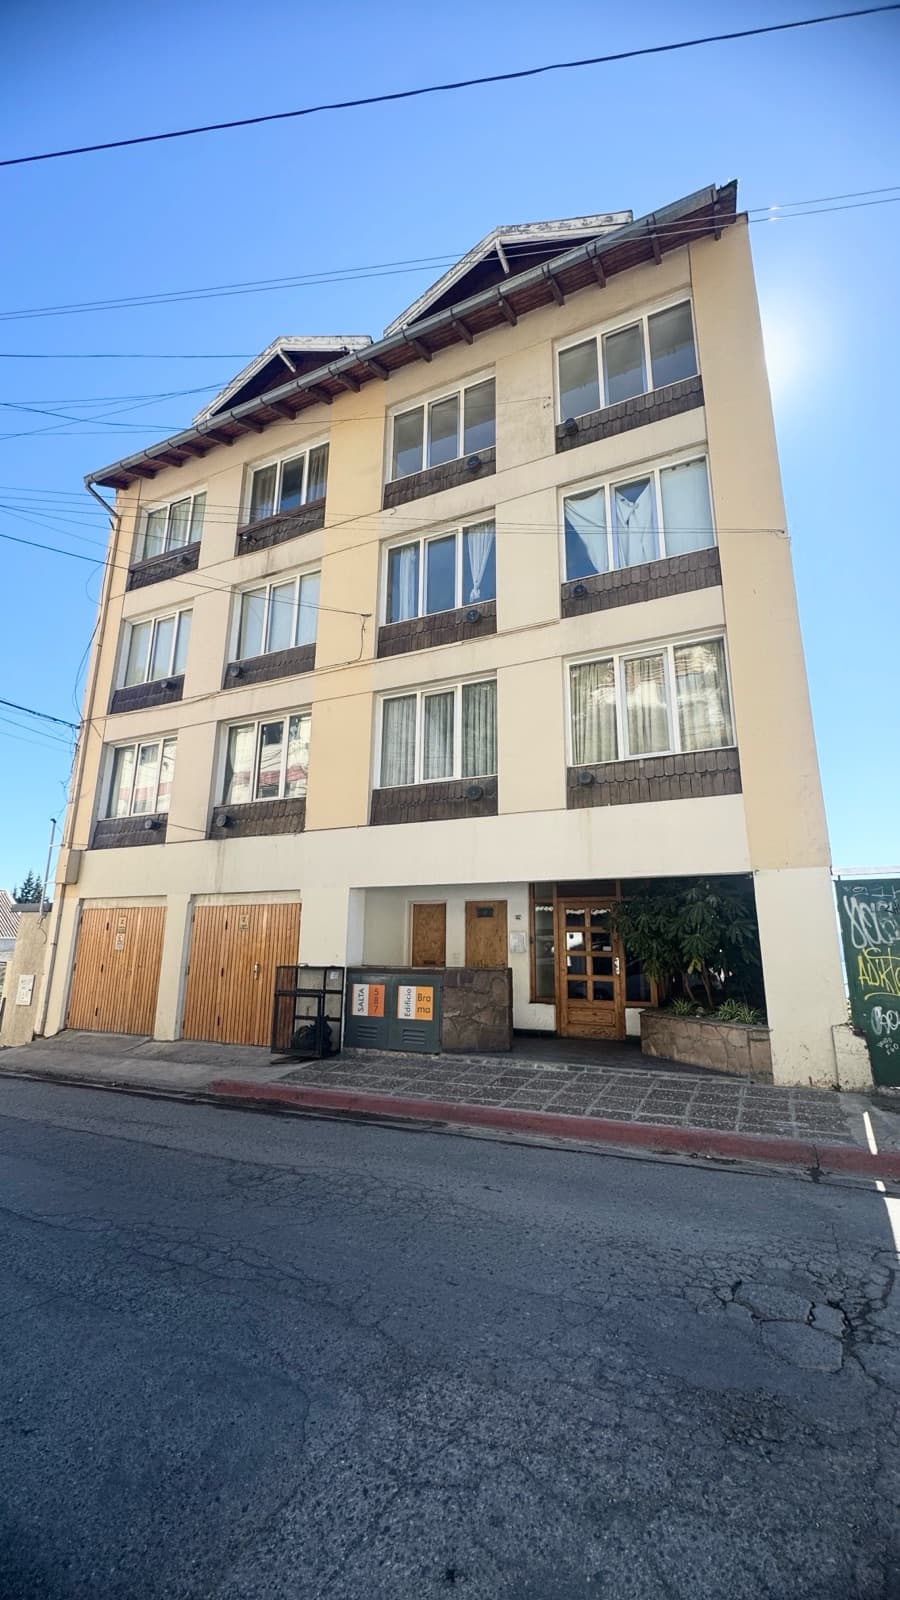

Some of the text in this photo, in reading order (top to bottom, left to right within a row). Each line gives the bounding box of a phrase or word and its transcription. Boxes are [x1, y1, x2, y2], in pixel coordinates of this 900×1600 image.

[357, 987, 366, 1013] SALTA
[404, 988, 413, 1017] Edificio
[417, 993, 431, 1002] Bra
